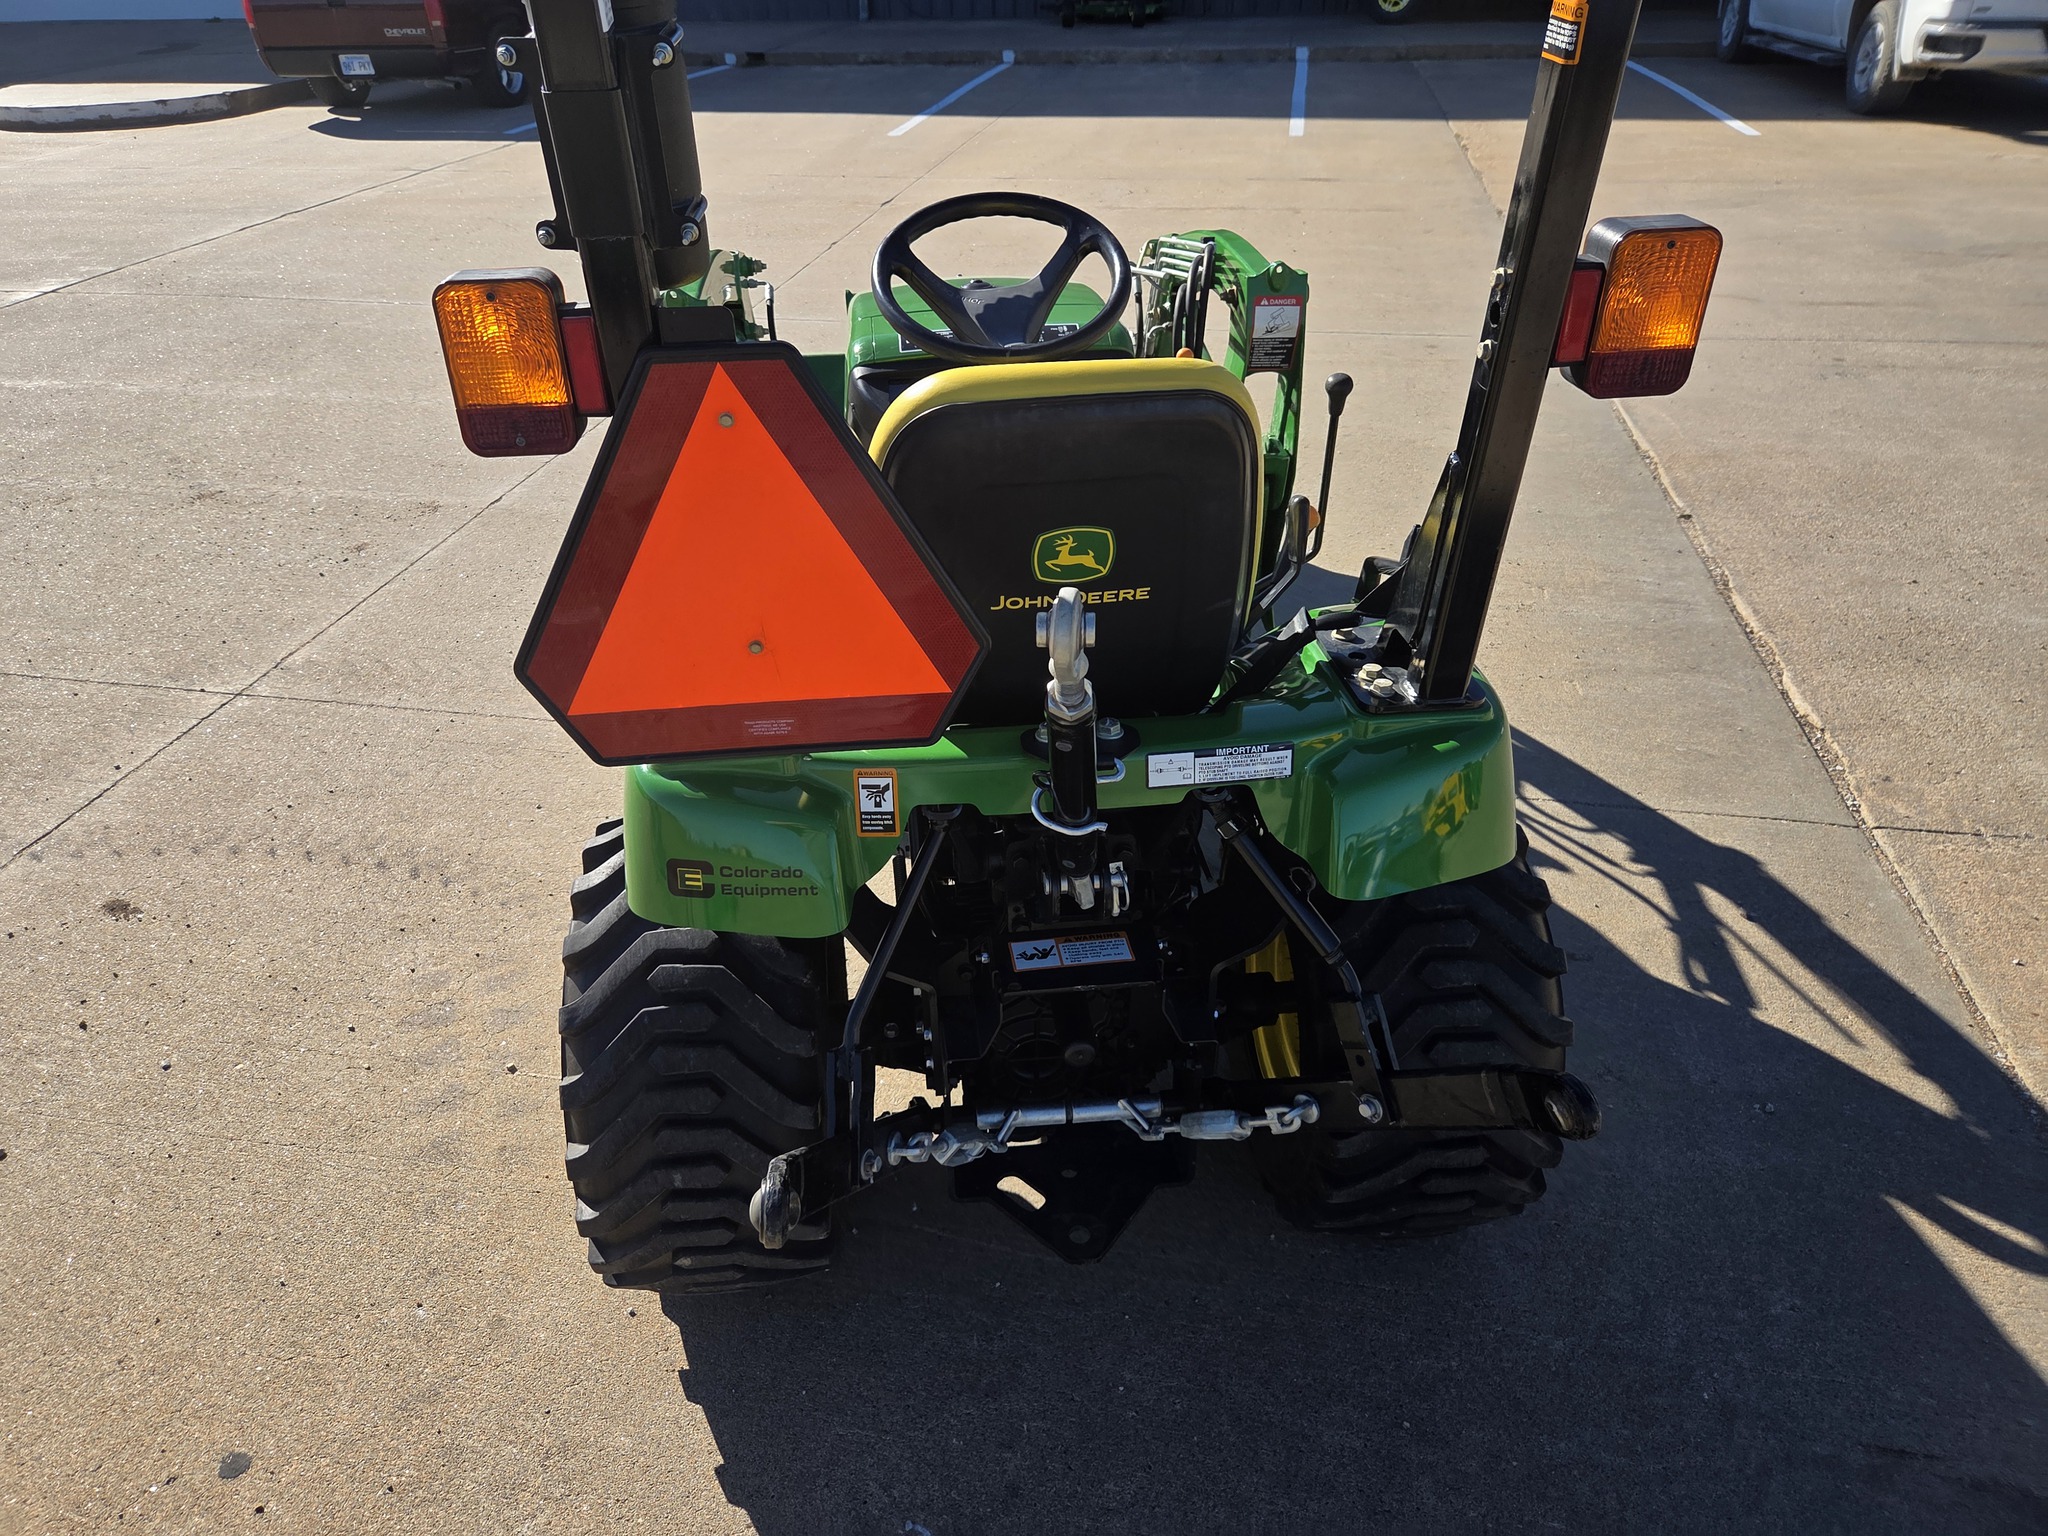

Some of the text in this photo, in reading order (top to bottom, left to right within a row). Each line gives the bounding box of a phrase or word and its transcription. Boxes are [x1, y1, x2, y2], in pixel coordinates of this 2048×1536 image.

[384, 28, 426, 36] CHEVROLET
[990, 594, 1055, 611] JOHN
[1216, 744, 1270, 756] IMPORTANT
[719, 865, 804, 878] Colorado
[720, 884, 819, 898] Equipment
[1073, 932, 1120, 941] WARNING
